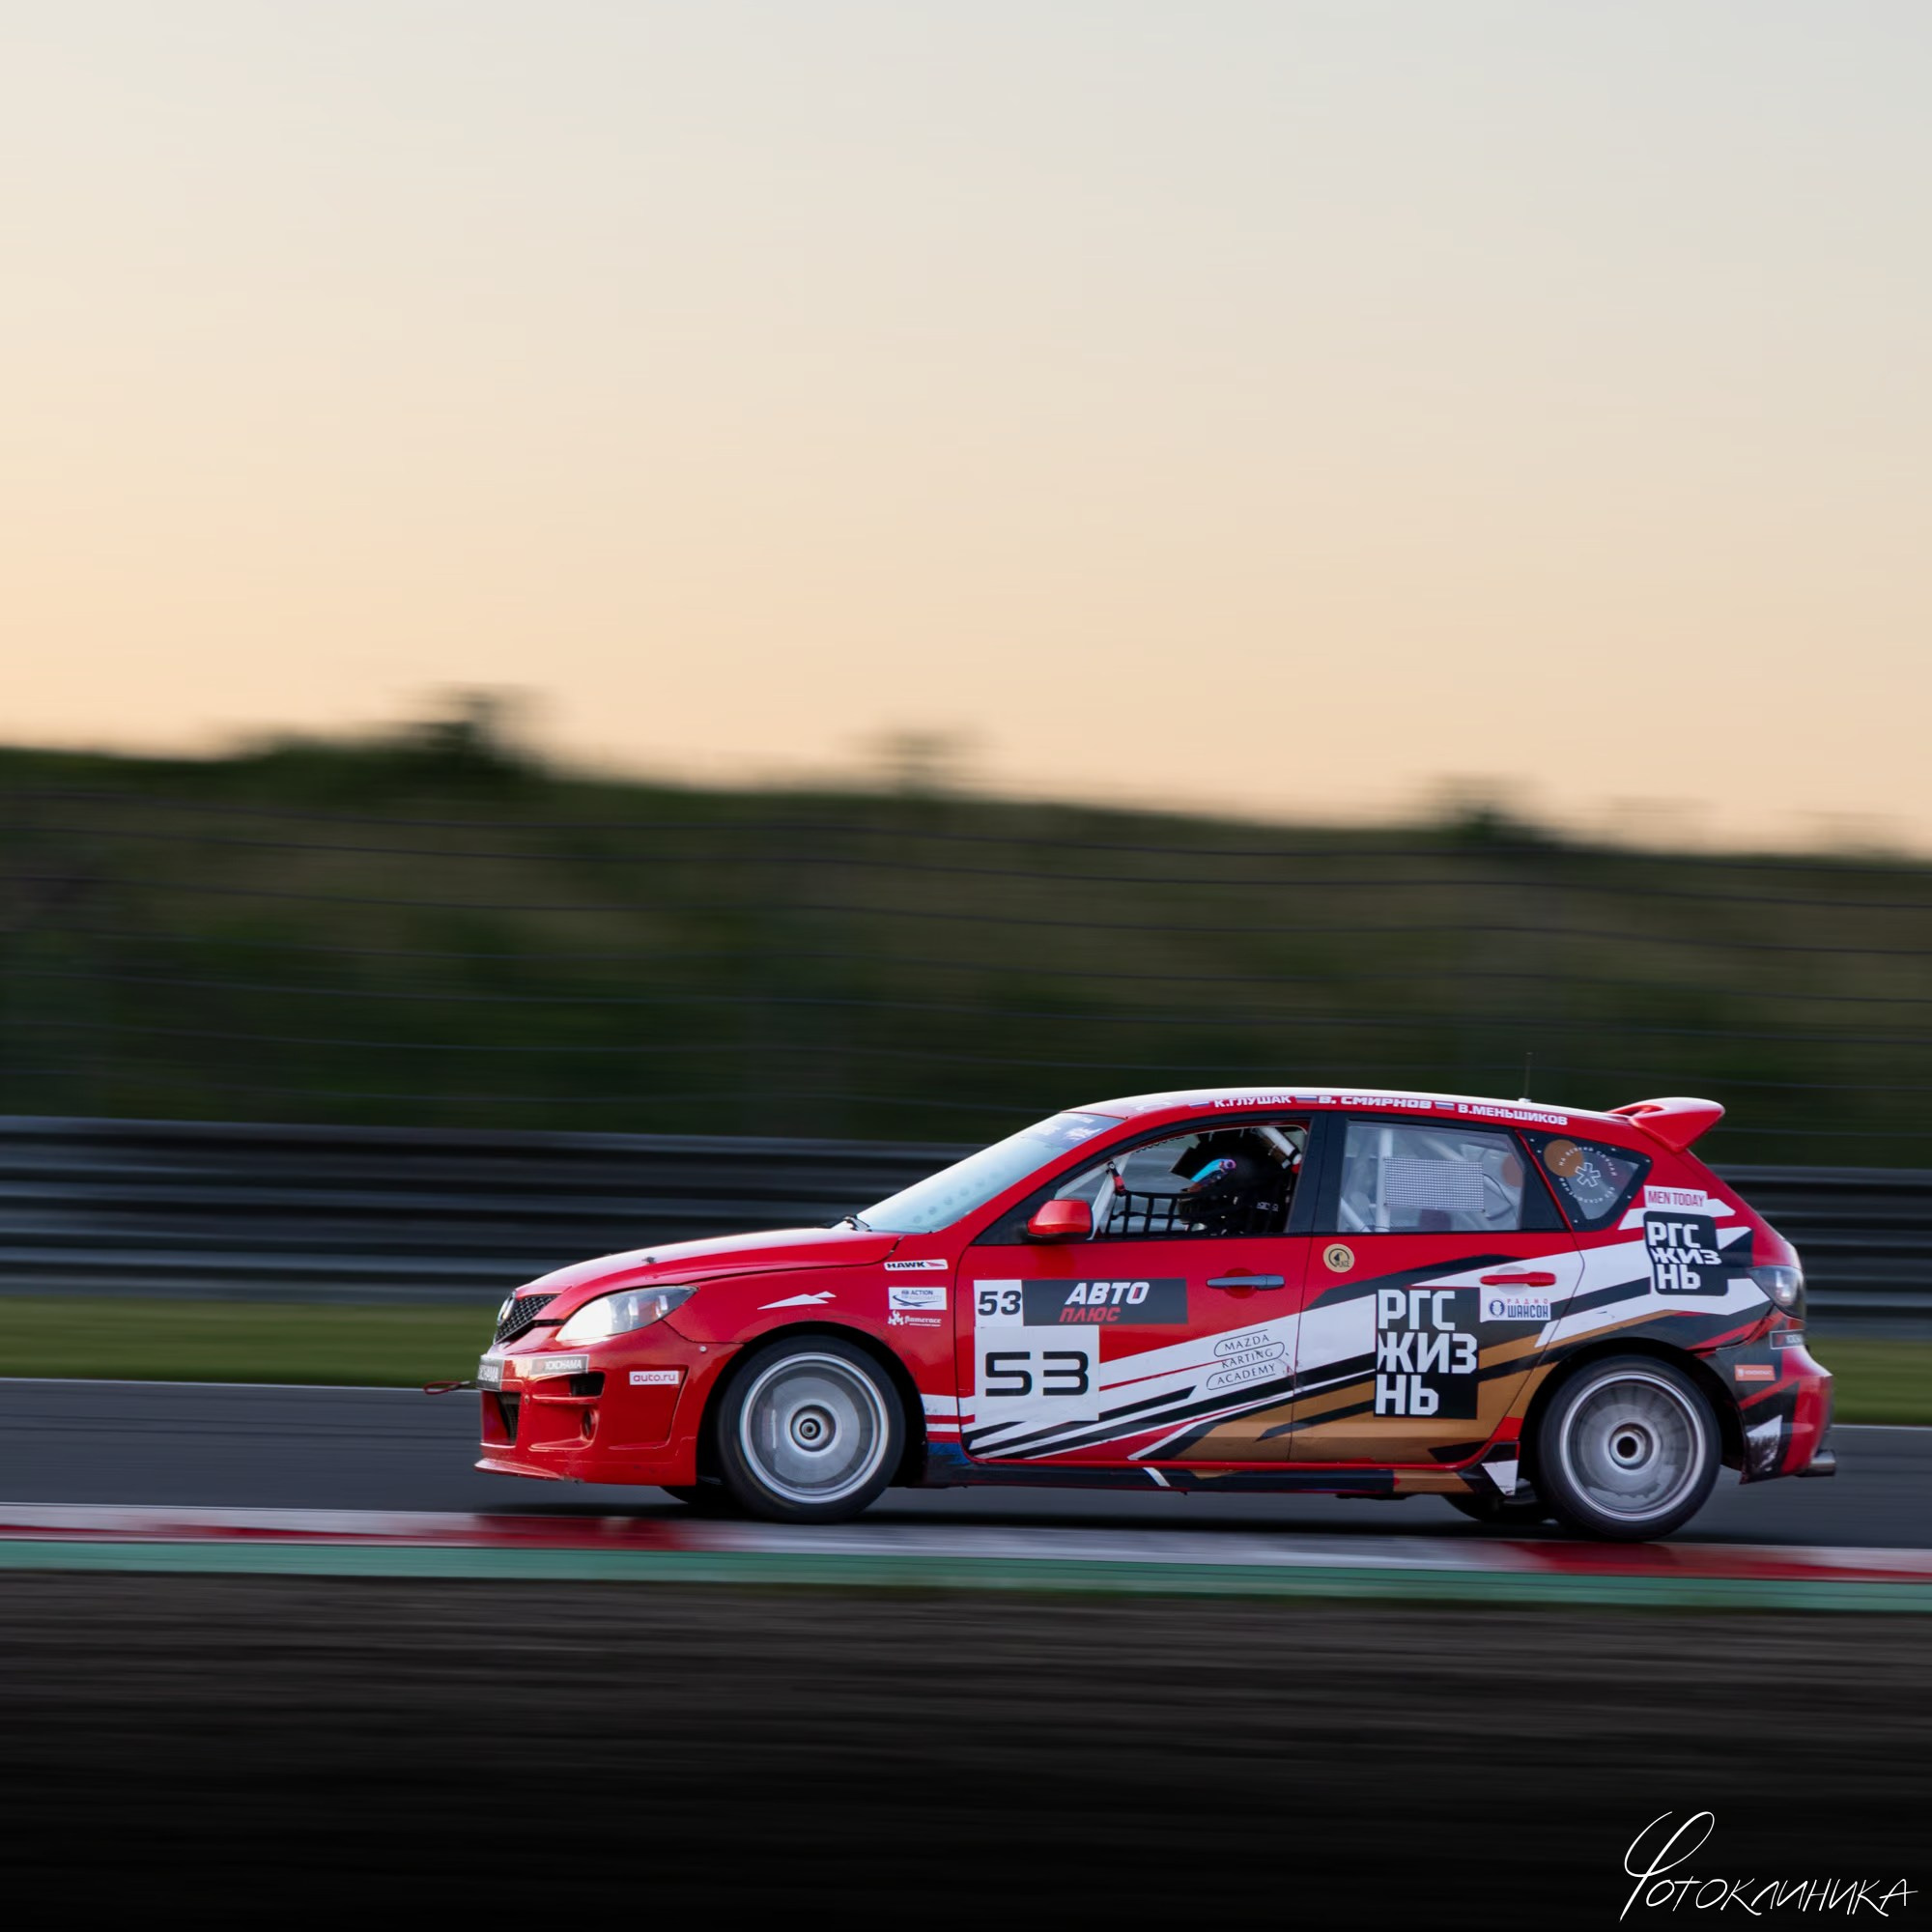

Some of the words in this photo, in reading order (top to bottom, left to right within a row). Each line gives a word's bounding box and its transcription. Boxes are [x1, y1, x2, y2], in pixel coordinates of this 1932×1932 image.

[1214, 1095, 1292, 1108] К.ГЛУШАК
[1341, 1096, 1432, 1109] СМИРНОВ
[1458, 1103, 1568, 1125] В.МЕНЬШИКОВ
[1647, 1190, 1671, 1205] MEN
[1672, 1192, 1705, 1207] TODAY
[1646, 1221, 1701, 1249] РГС
[1649, 1247, 1722, 1265] ЖИЗ
[1656, 1264, 1701, 1290] НЬ
[978, 1291, 1022, 1317] 53
[1065, 1282, 1150, 1305] АВТО
[1059, 1307, 1122, 1323] ПЛЮС
[1378, 1289, 1456, 1331] РГС
[1507, 1304, 1548, 1318] ШАНСОН
[1224, 1334, 1270, 1351] MAZDA
[1378, 1332, 1478, 1375] ЖИЗ
[1221, 1349, 1273, 1369] KARTING
[633, 1374, 676, 1382] auto.ru
[985, 1350, 1090, 1397] 53
[1217, 1363, 1276, 1385] ACADEMY
[1375, 1375, 1439, 1416] НЬ
